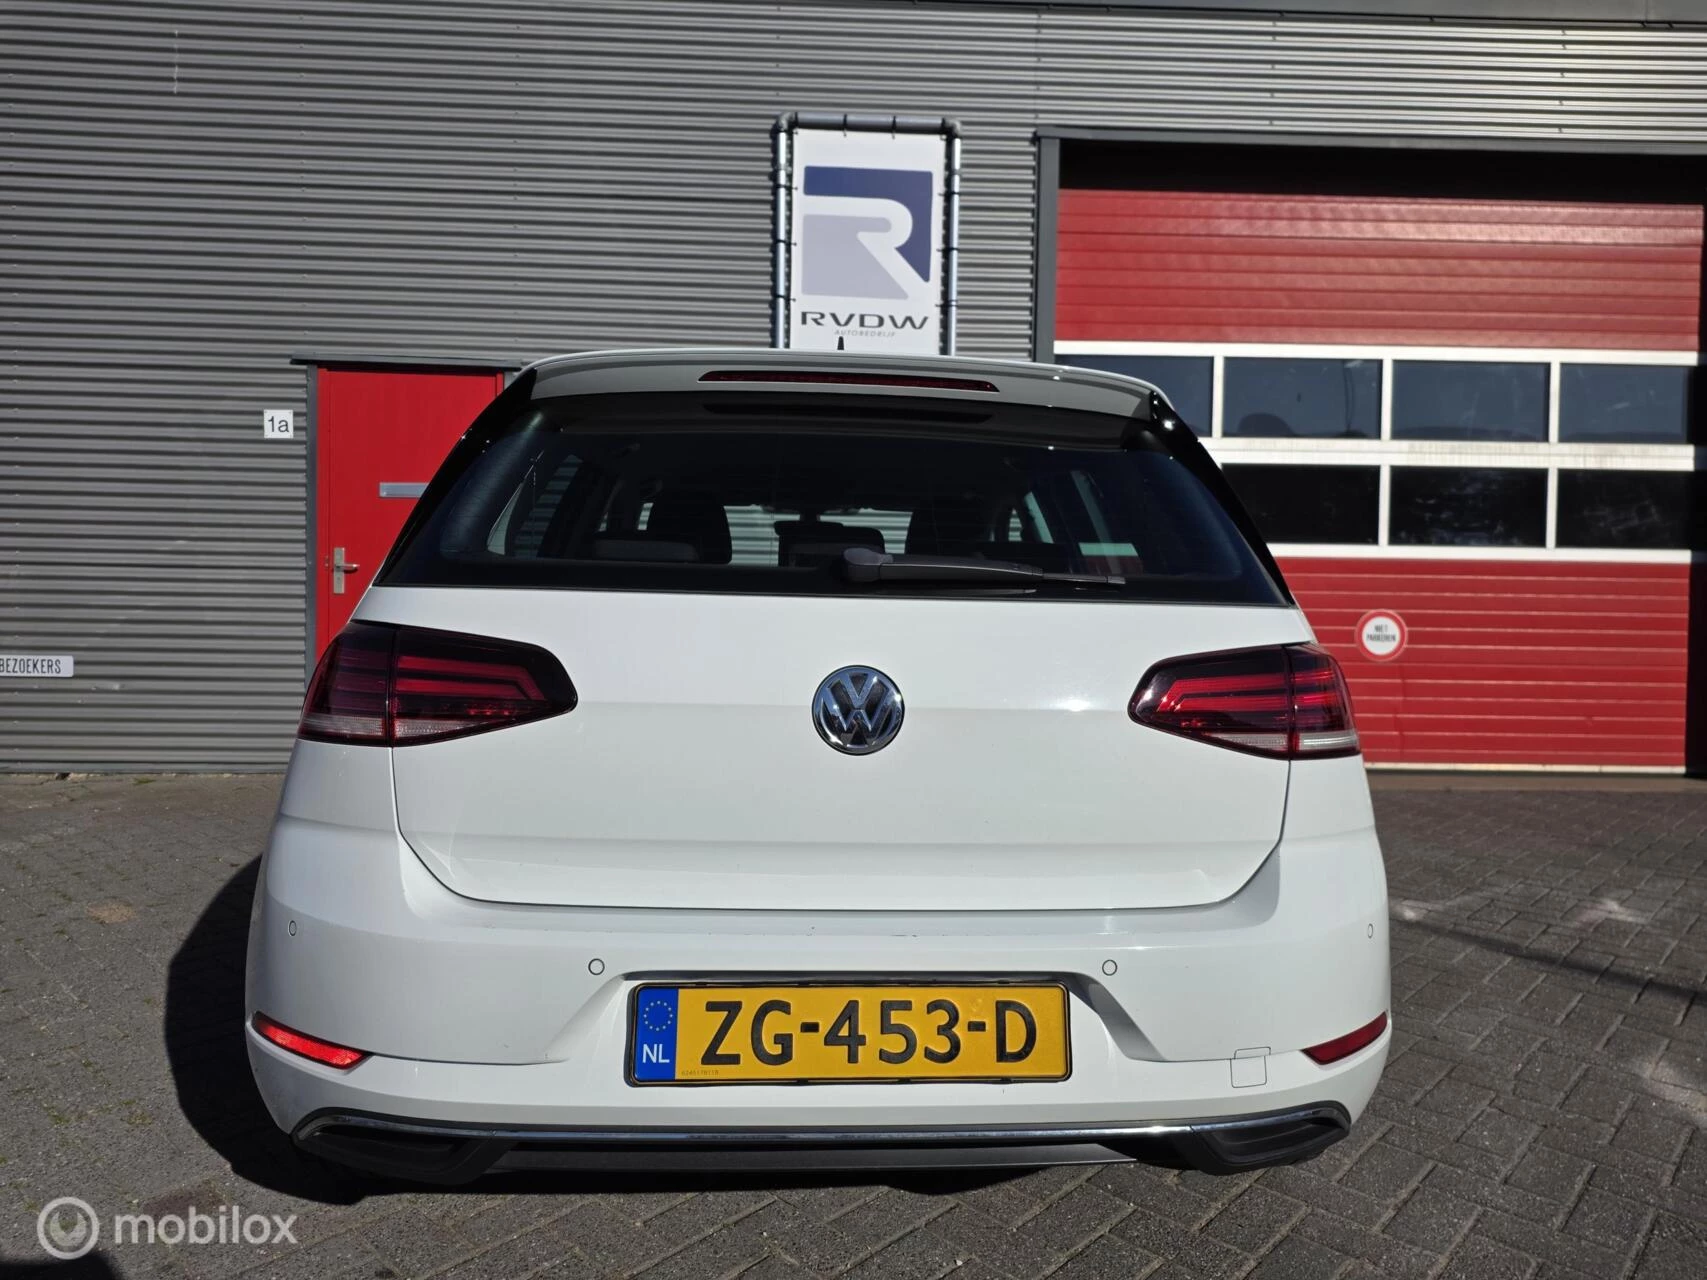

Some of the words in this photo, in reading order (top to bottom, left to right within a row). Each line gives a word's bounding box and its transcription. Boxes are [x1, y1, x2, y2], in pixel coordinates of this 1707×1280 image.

[801, 311, 928, 329] RVDW
[268, 415, 290, 434] 1a
[0, 658, 61, 674] BEZOEKERS
[701, 999, 1037, 1066] ZG-453-D
[642, 1043, 670, 1064] NL
